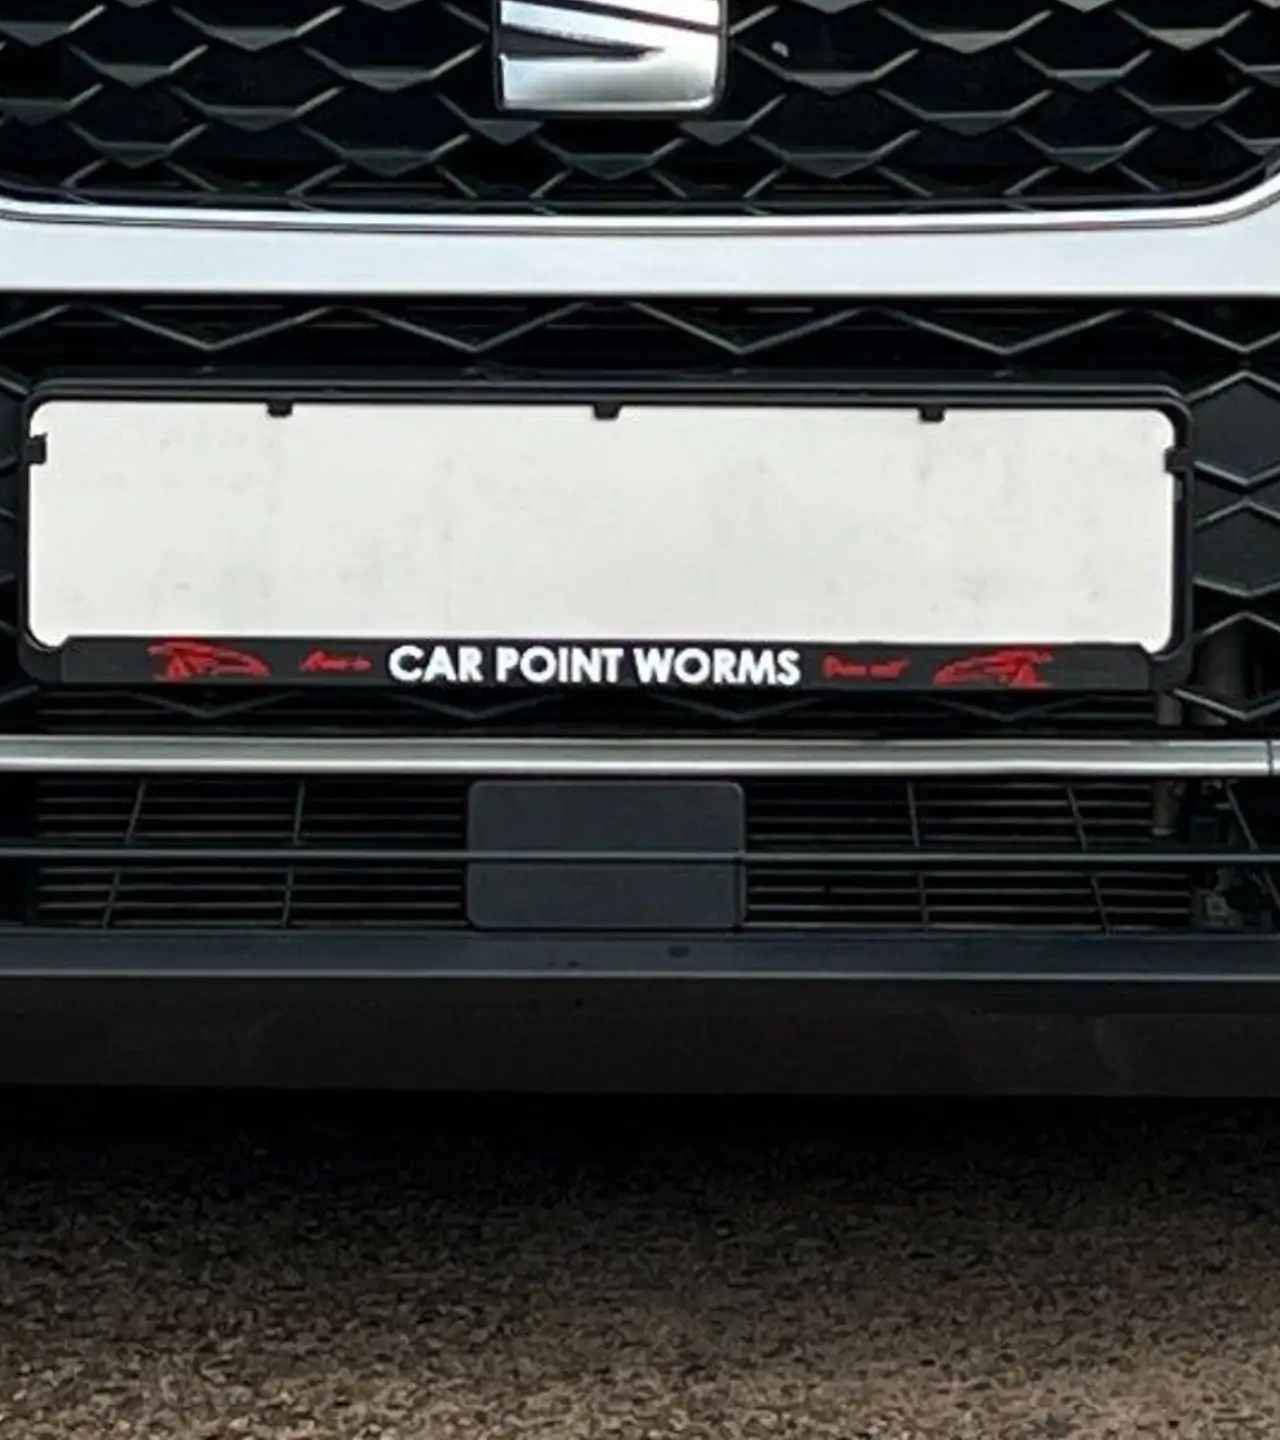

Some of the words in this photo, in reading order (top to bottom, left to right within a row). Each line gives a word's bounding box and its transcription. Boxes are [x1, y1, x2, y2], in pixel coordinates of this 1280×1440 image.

[388, 645, 484, 683] CAR
[496, 647, 623, 684] POINT
[634, 648, 802, 687] WORMS
